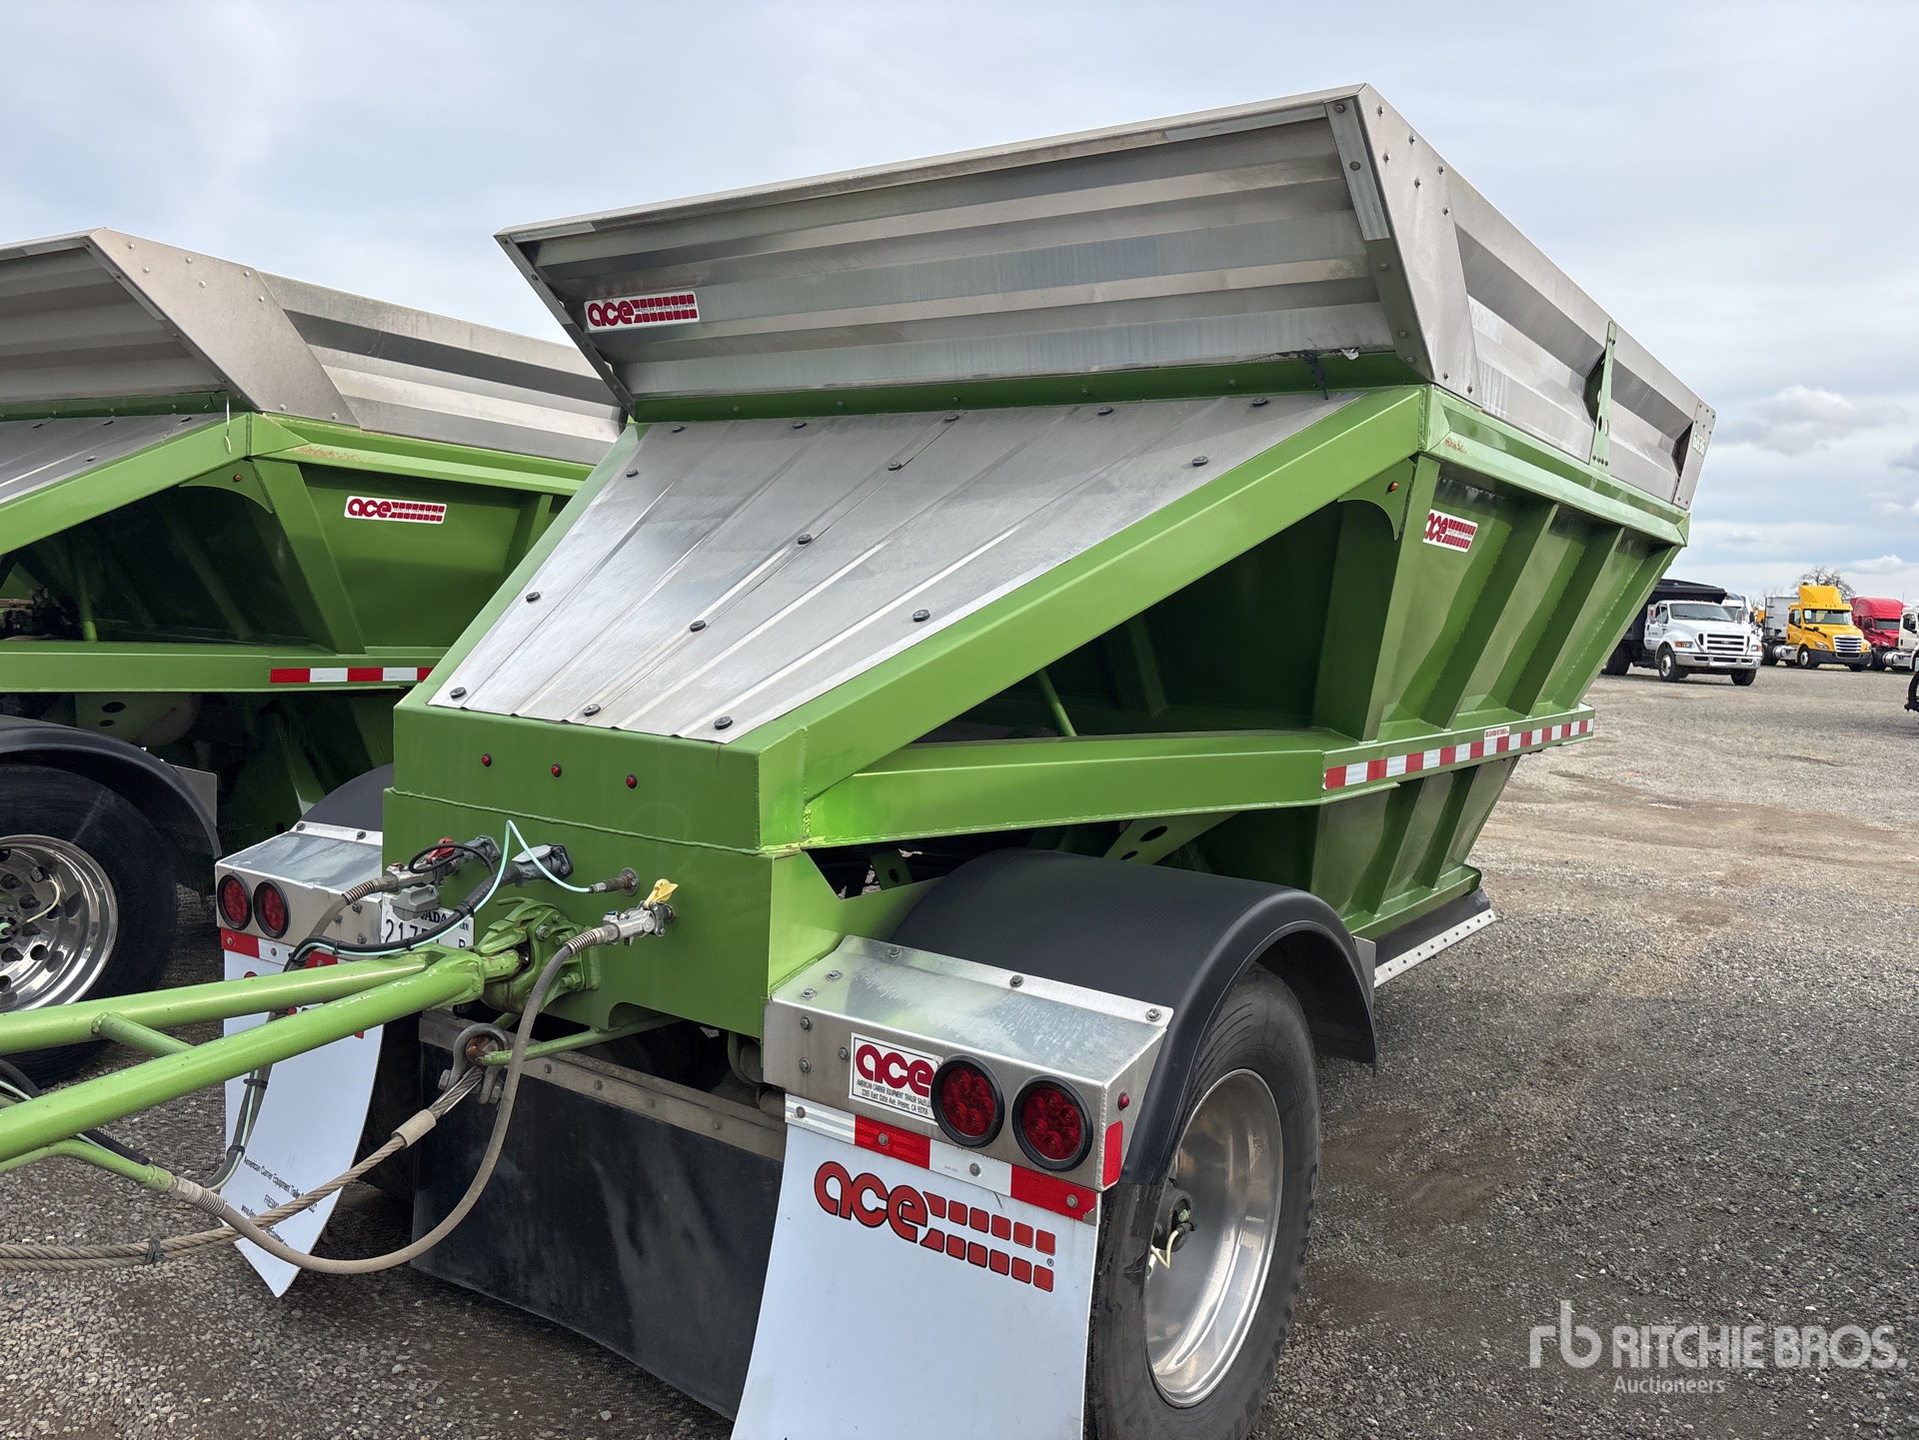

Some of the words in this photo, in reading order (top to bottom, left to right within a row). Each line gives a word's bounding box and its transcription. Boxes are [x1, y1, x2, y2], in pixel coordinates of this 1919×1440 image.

[587, 300, 634, 327] ace
[347, 498, 392, 518] ace
[855, 1043, 934, 1098] ace
[814, 1160, 928, 1243] ace
